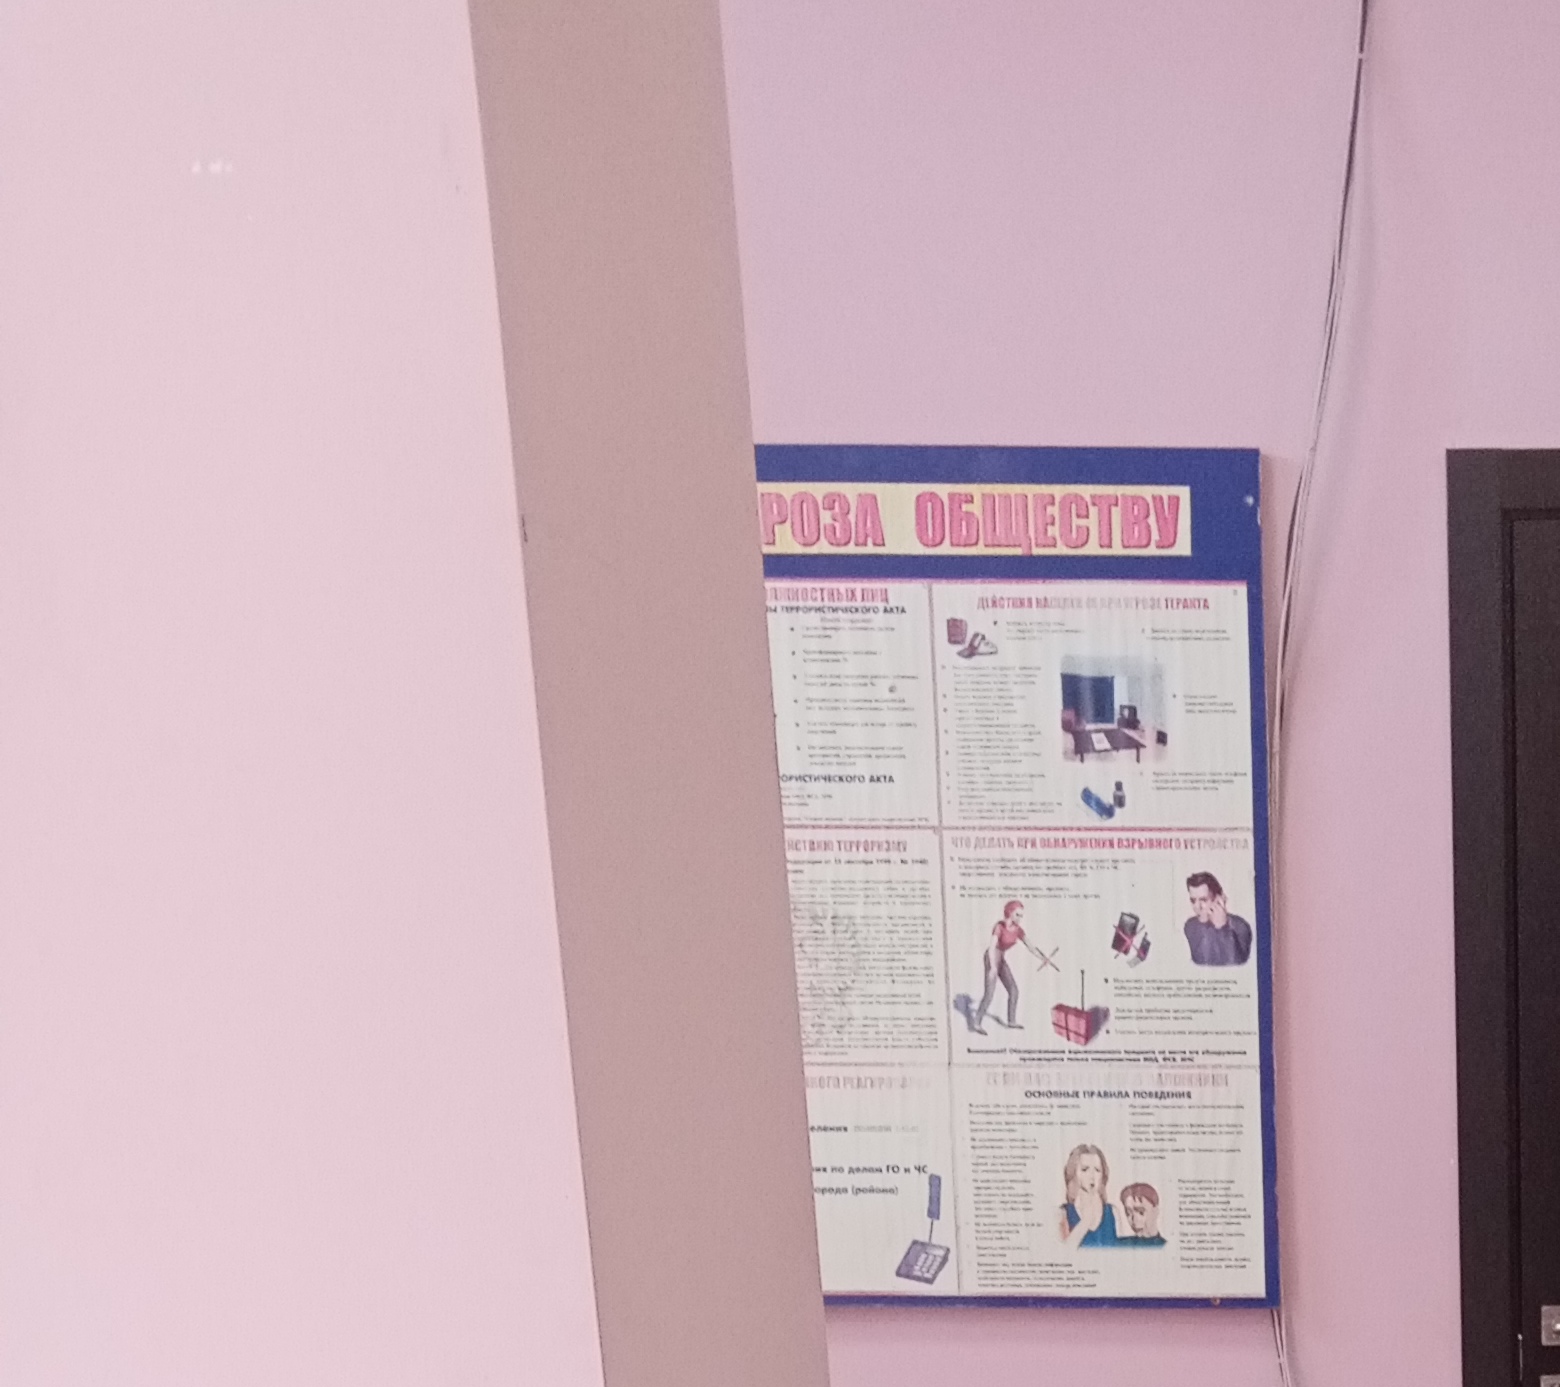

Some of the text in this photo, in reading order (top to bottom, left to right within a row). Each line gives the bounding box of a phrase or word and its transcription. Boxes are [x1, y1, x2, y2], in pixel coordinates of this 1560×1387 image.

[760, 491, 1180, 556] РОЗА ОБЩЕСТВУ
[882, 605, 907, 614] АКТА
[869, 774, 895, 784] АКТА
[1024, 1090, 1192, 1100] ОСНОВНЫЕ ПРАВИЛА ПОВЕДЕНИЯ
[914, 1164, 929, 1174] ЧС
